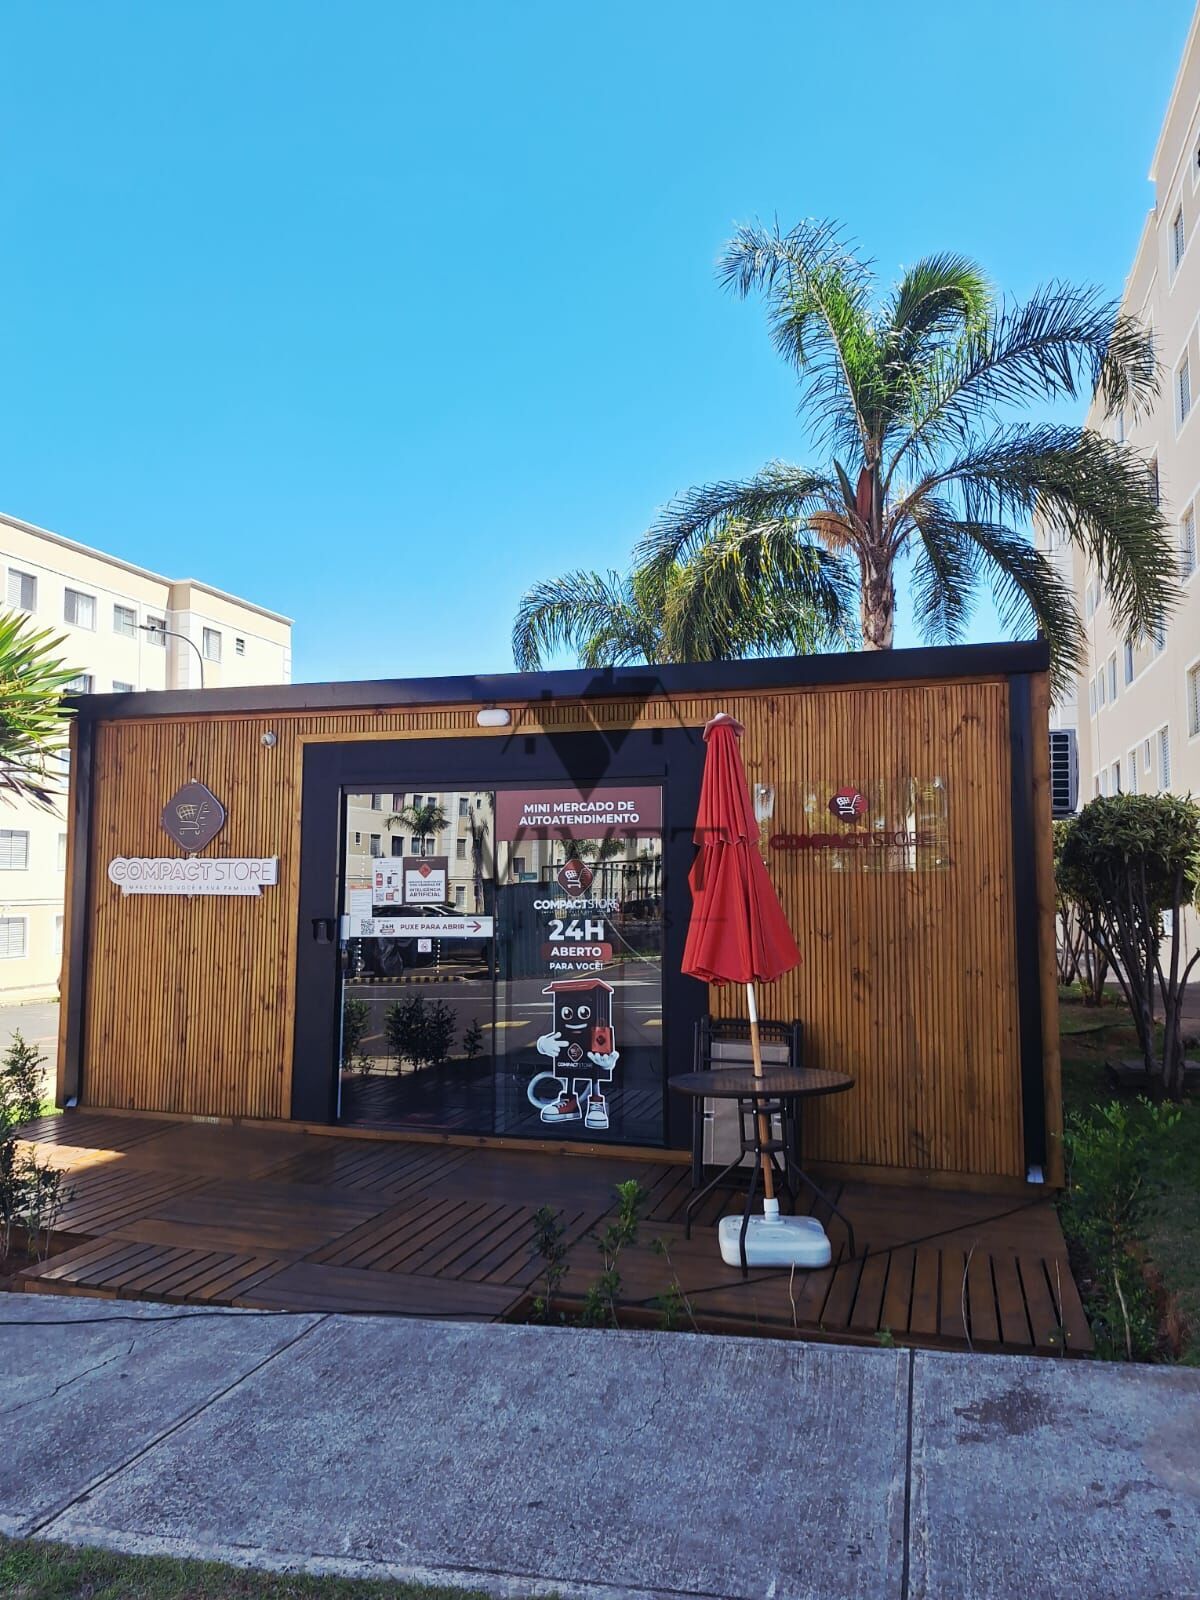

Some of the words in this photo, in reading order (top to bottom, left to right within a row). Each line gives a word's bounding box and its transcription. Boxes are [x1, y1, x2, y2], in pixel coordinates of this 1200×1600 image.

[524, 804, 550, 814] MINI
[553, 802, 614, 812] MERCADO
[618, 801, 635, 811] DE
[519, 813, 640, 826] AUTOATENDIMENTO
[548, 919, 604, 941] 24H
[550, 946, 602, 957] ABERTO
[549, 962, 574, 971] PARA
